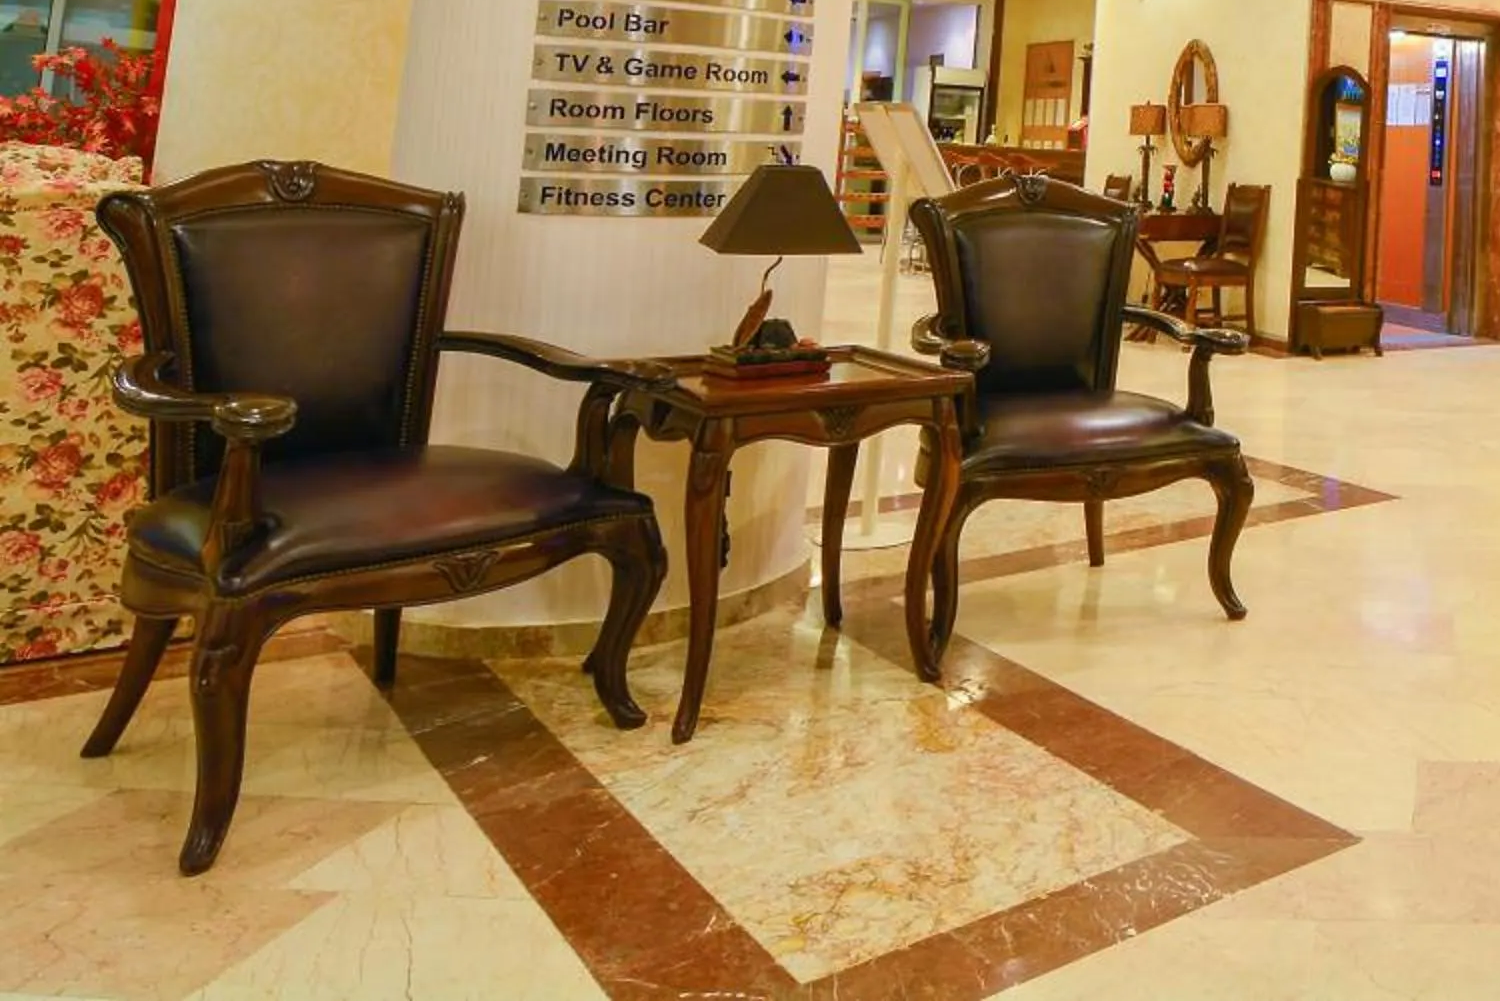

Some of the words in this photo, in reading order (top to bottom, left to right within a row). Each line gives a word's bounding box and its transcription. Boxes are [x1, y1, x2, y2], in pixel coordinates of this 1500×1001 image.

[557, 8, 615, 31] Pool
[623, 13, 670, 36] Bar
[555, 53, 590, 74] TV
[596, 55, 614, 76] &
[623, 58, 698, 81] Game
[705, 62, 769, 85] Room
[549, 98, 625, 121] Room
[635, 102, 714, 125] Floors
[545, 142, 648, 172] Meeting
[656, 147, 728, 168] Room
[540, 186, 635, 210] Fitness
[645, 189, 726, 211] Center
